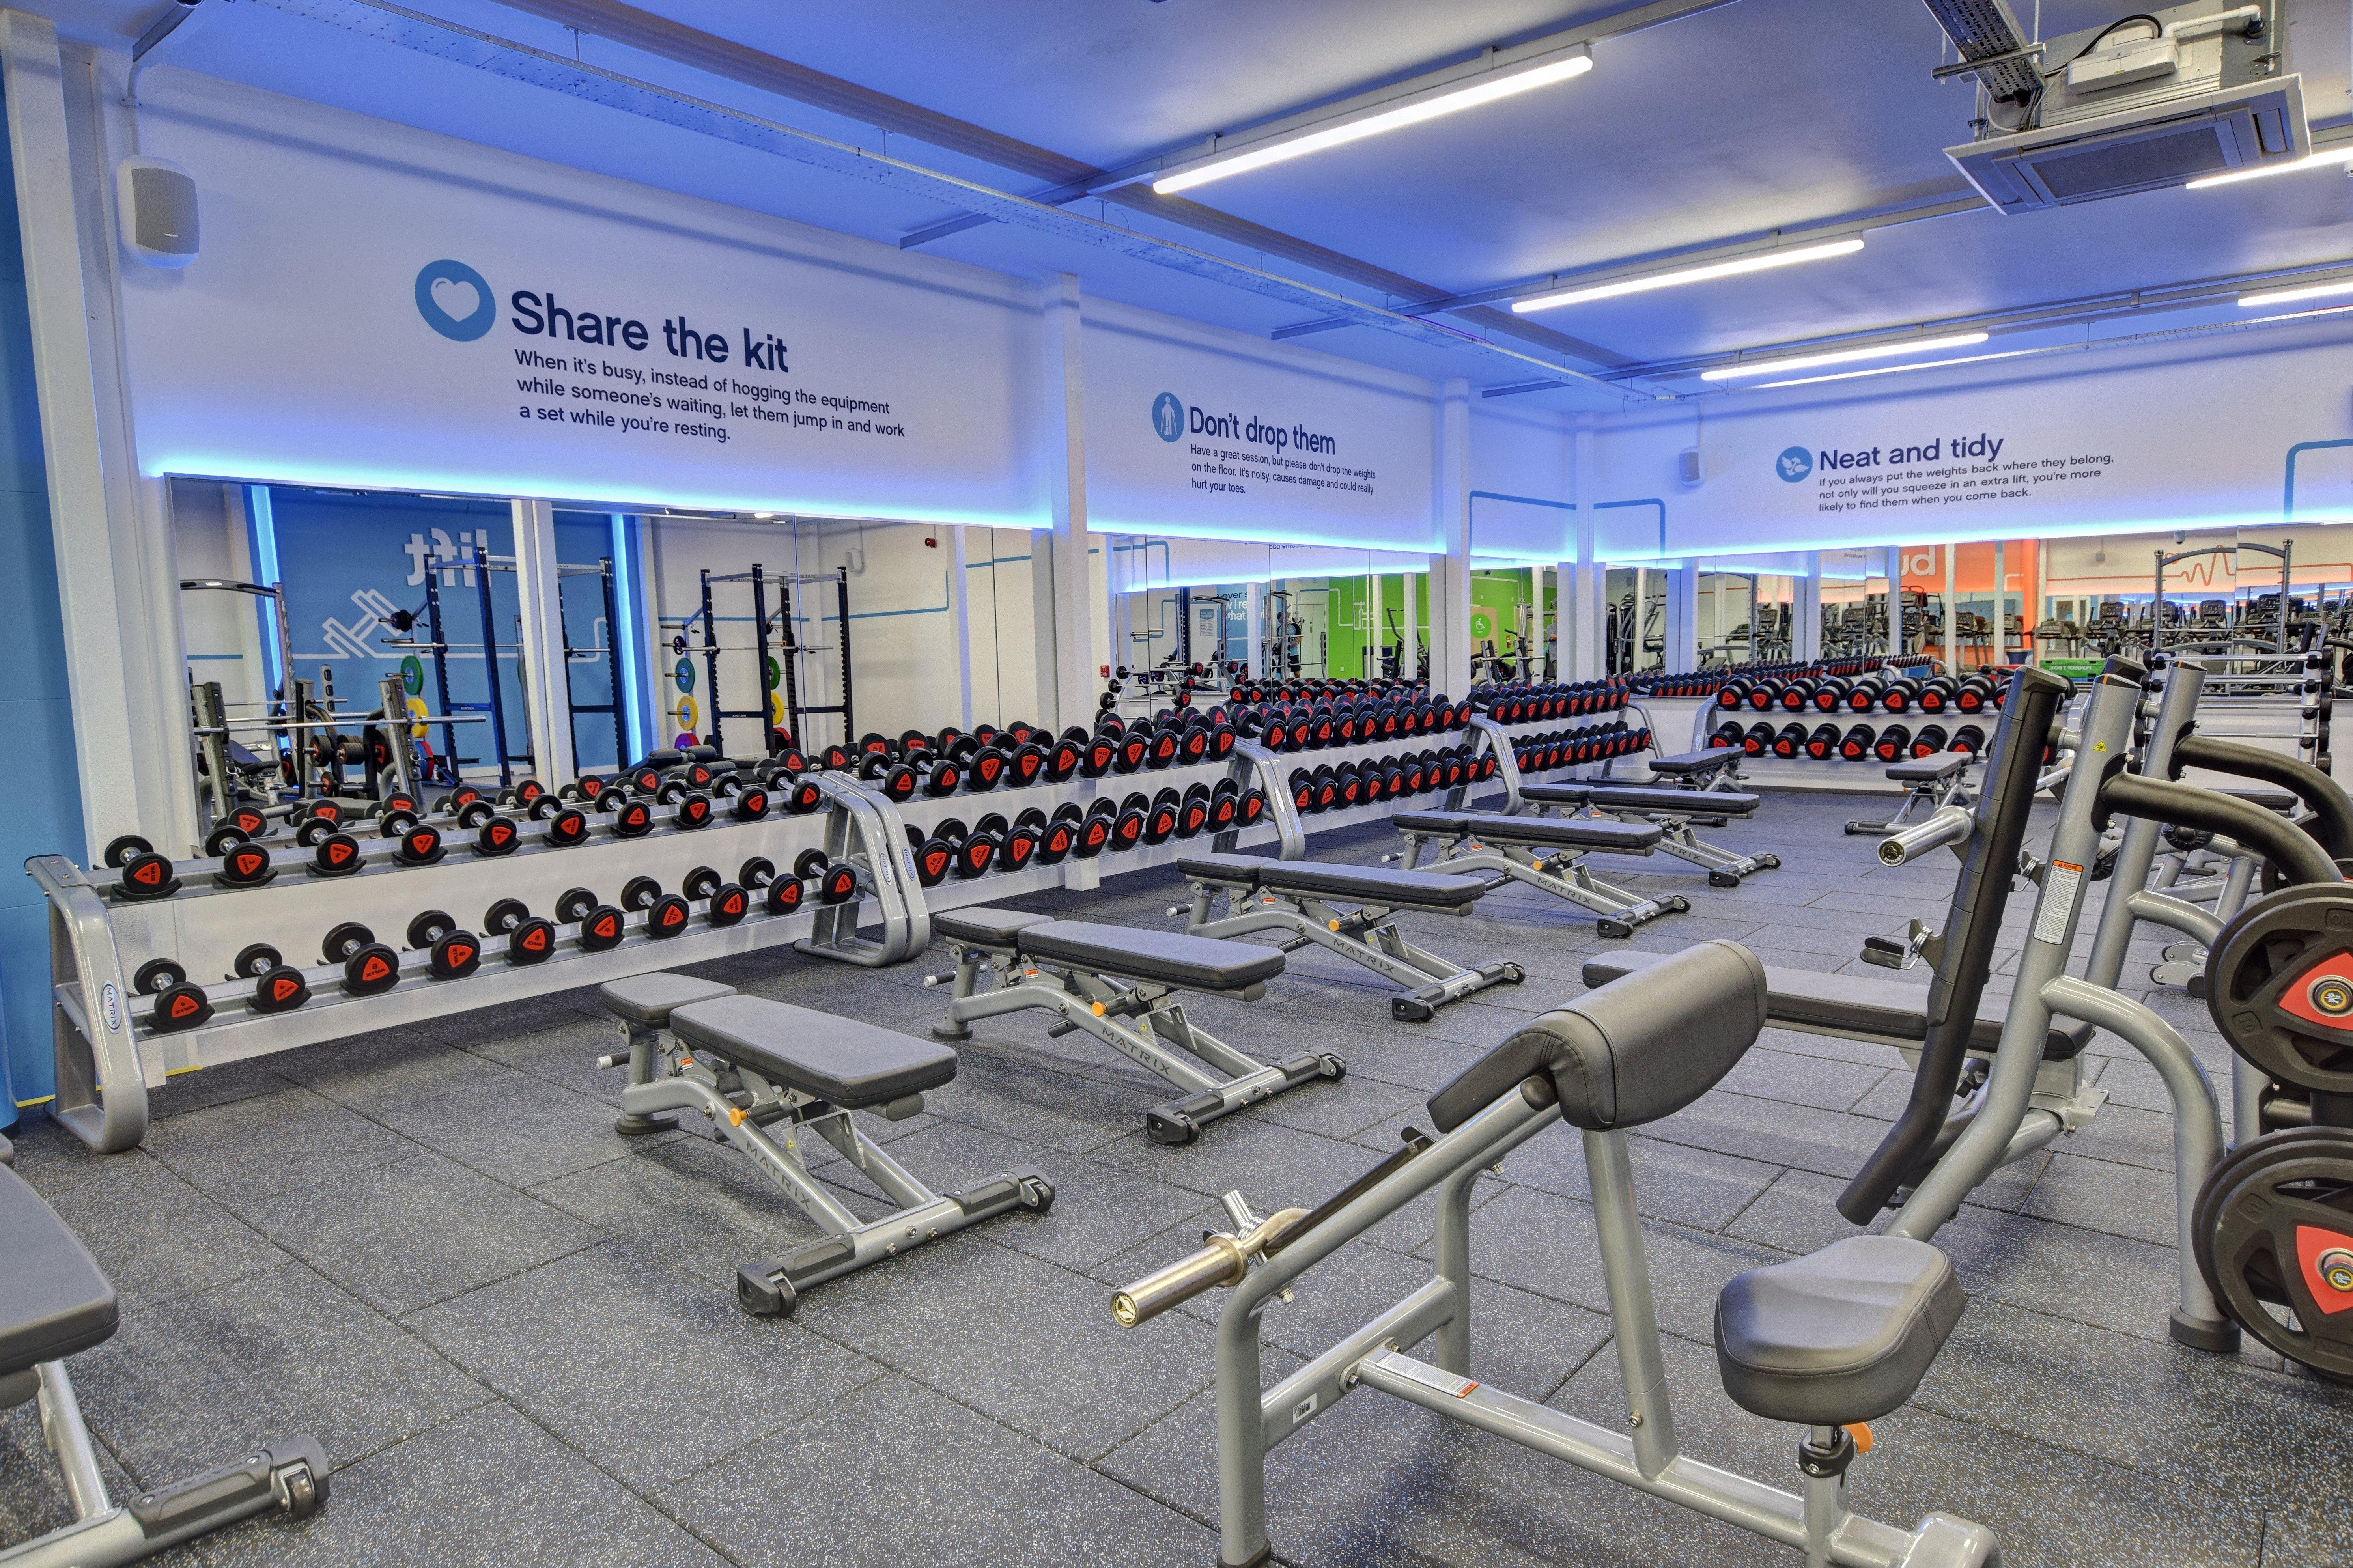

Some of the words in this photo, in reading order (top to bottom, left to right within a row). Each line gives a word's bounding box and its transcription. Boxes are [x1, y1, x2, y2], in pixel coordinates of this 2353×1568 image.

[512, 291, 648, 351] Share
[663, 316, 729, 363] the
[743, 327, 788, 373] kit
[514, 349, 567, 371] When
[573, 357, 596, 375] it's
[603, 360, 645, 385] busy,
[651, 368, 708, 390] instead
[713, 378, 727, 392] of
[732, 379, 790, 405] hogging
[795, 388, 816, 404] the
[821, 396, 889, 414] equipment
[517, 377, 565, 396] while
[571, 386, 661, 407] someone's
[667, 398, 726, 419] waiting,
[731, 402, 749, 418] let
[753, 405, 789, 423] them
[794, 411, 827, 431] jump
[832, 416, 843, 429] in
[848, 420, 871, 433] and
[875, 423, 905, 437] work
[520, 406, 530, 418] a
[537, 407, 565, 422] set
[570, 409, 615, 427] while
[621, 417, 669, 433] you're
[675, 423, 730, 443] resting.
[1190, 406, 1240, 440] Don't
[1246, 416, 1287, 454] drop
[1293, 424, 1335, 455] them
[1191, 444, 1210, 456] Have
[1220, 450, 1240, 461] great
[1242, 454, 1270, 466] session,
[1272, 455, 1283, 466] but
[1285, 457, 1306, 469] please
[1309, 461, 1324, 472] don't
[1326, 463, 1340, 476] drop
[1342, 466, 1352, 476] the
[1354, 469, 1376, 480] weights
[1820, 447, 1880, 470] Neat
[1889, 438, 1940, 464] and
[1951, 433, 2004, 463] tidy
[1192, 463, 1201, 472] on
[1204, 462, 1216, 473] the
[1218, 464, 1236, 476] floor.
[1240, 467, 1249, 478] It's
[1252, 470, 1270, 483] noisy,
[1273, 474, 1296, 483] causes
[1298, 475, 1324, 489] damage
[1327, 480, 1338, 488] and
[1340, 482, 1356, 491] could
[1358, 484, 1373, 496] really
[1192, 478, 1207, 489] hurt
[1210, 482, 1226, 493] your
[1228, 483, 1246, 493] toes.
[1829, 479, 1845, 488] you
[1849, 475, 1883, 484] always
[1887, 472, 1903, 483] put
[1926, 467, 1967, 478] weights
[1972, 463, 1998, 473] back
[2003, 461, 2037, 470] where
[2041, 458, 2066, 469] they
[2070, 455, 2114, 465] belong,
[1838, 489, 1858, 498] only
[1862, 486, 1877, 495] will
[1881, 487, 1899, 496] you
[1903, 483, 1946, 494] squeeze
[1981, 478, 2008, 486] extra
[2013, 474, 2028, 484] lift,
[2033, 472, 2067, 484] you're
[2071, 470, 2101, 479] more
[1819, 502, 1843, 513] likely
[1860, 499, 1878, 508] find
[1912, 496, 1939, 504] when
[1944, 495, 1962, 504] you
[1966, 492, 1996, 500] come
[2001, 488, 2031, 498] back.
[1061, 758, 1073, 767] ZIVA
[905, 853, 913, 875] MATRIX
[932, 856, 943, 872] ZIVA
[977, 849, 987, 864] ZIVA
[1538, 877, 1591, 904] MATRIX
[667, 909, 675, 923] ZIVA
[366, 968, 386, 977] ZIVA
[1333, 939, 1394, 974] MATRIX
[107, 988, 118, 1025] MATRIX
[278, 986, 295, 997] ZIVA
[176, 1005, 194, 1014] ZIVA
[1103, 1027, 1170, 1075] MATRIX
[746, 1140, 812, 1210] MATRIX
